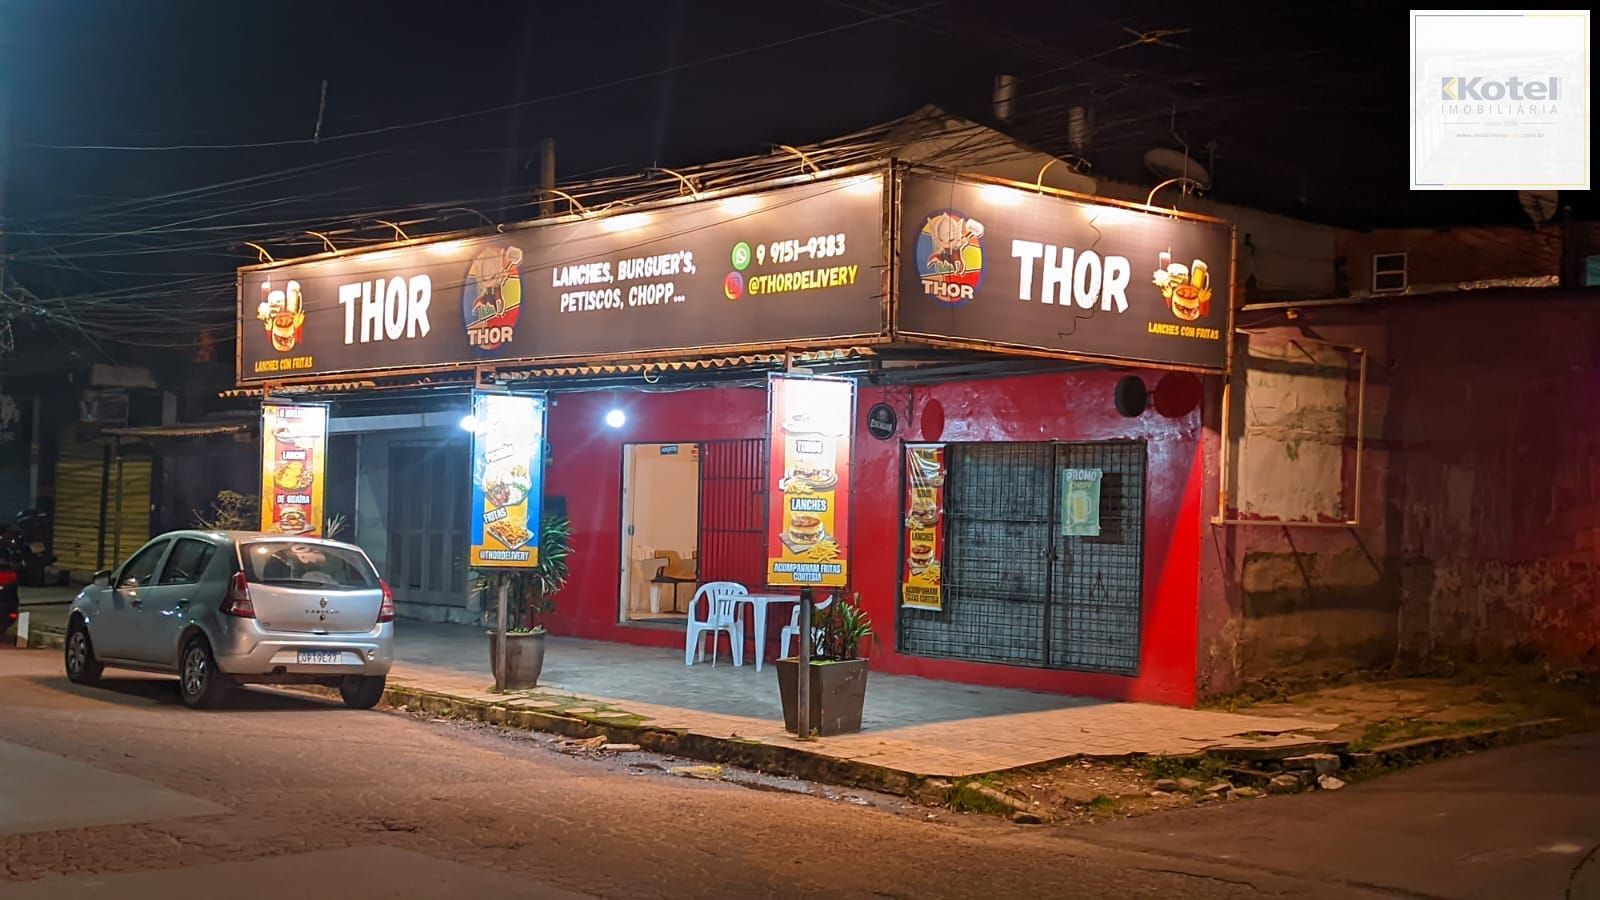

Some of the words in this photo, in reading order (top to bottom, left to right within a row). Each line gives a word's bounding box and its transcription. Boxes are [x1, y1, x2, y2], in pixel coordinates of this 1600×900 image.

[756, 245, 765, 265] 9
[770, 234, 845, 263] 9151-9383
[552, 260, 614, 287] LANCHES,
[618, 251, 696, 281] BURGUER'S,
[1011, 239, 1131, 314] THOR
[748, 265, 859, 295] @THORDELIVERY
[560, 286, 624, 313] PETISCOS,
[628, 282, 686, 307] CHOPP...
[921, 279, 974, 300] THOR
[339, 274, 431, 345] THOR
[467, 326, 513, 346] THOR
[1148, 322, 1179, 336] LANCHES
[1196, 328, 1219, 340] FRITAS
[255, 360, 279, 373] LANCHES
[292, 356, 313, 369] FRITAS
[1066, 470, 1097, 481] PROMO
[277, 495, 286, 504] DE
[791, 499, 827, 511] LANCHES
[483, 507, 507, 523] FRITAS
[912, 532, 934, 541] LANCHES
[480, 550, 530, 561] @THORDELIVERY
[774, 563, 820, 573] ACOMPANHAM
[821, 565, 841, 574] FRITAS
[793, 572, 822, 581] CORTESIA
